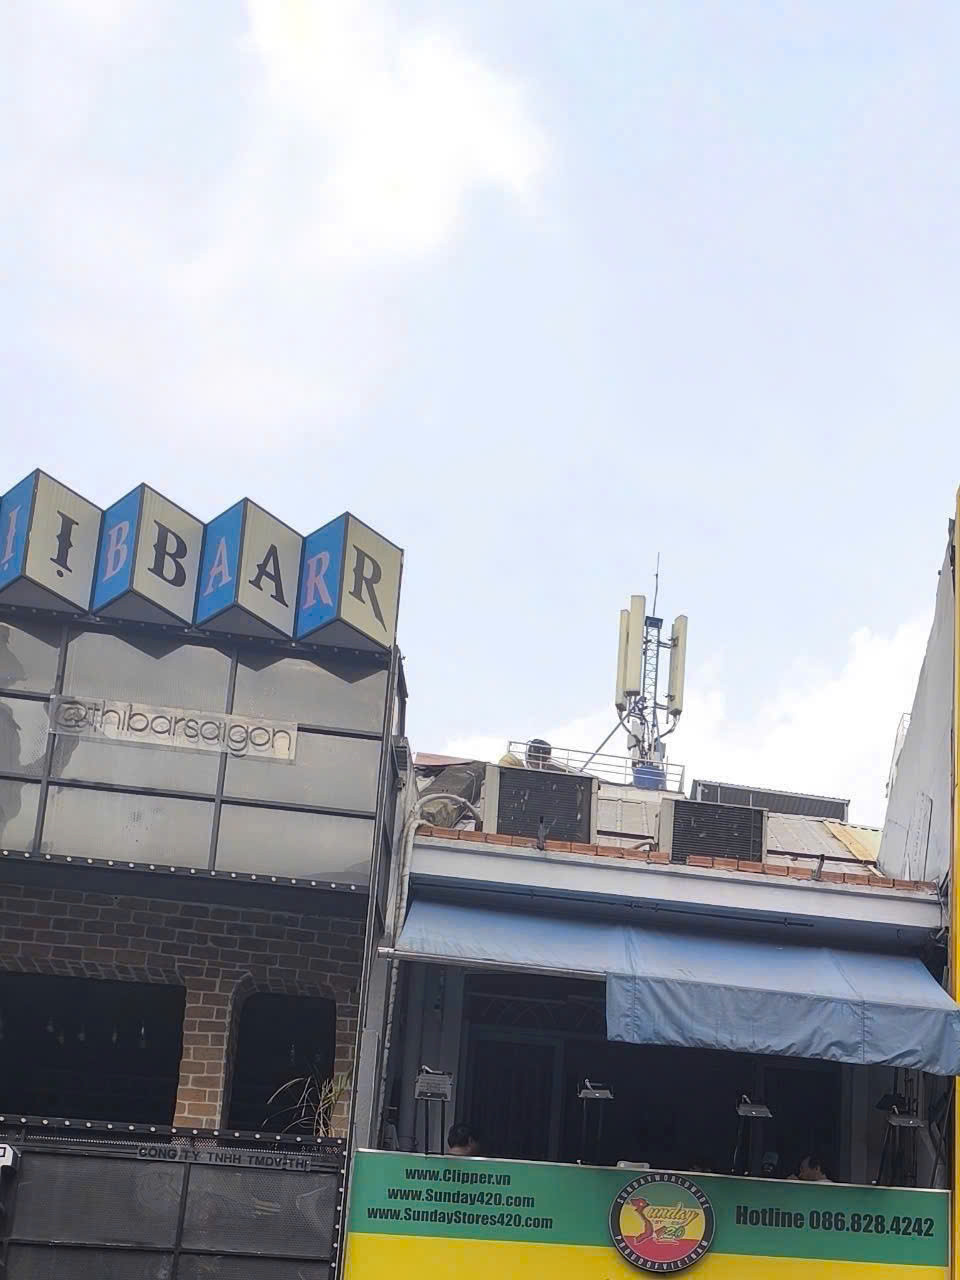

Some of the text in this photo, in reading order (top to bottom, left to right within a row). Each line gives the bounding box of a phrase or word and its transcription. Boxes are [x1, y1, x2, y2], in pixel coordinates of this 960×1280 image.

[405, 1167, 512, 1186] www.Clipper.vn
[387, 1187, 535, 1209] www.Sunday420.com
[367, 1207, 553, 1230] www.SundayStores420.com
[735, 1204, 936, 1238] Hotline 086.828.4242
